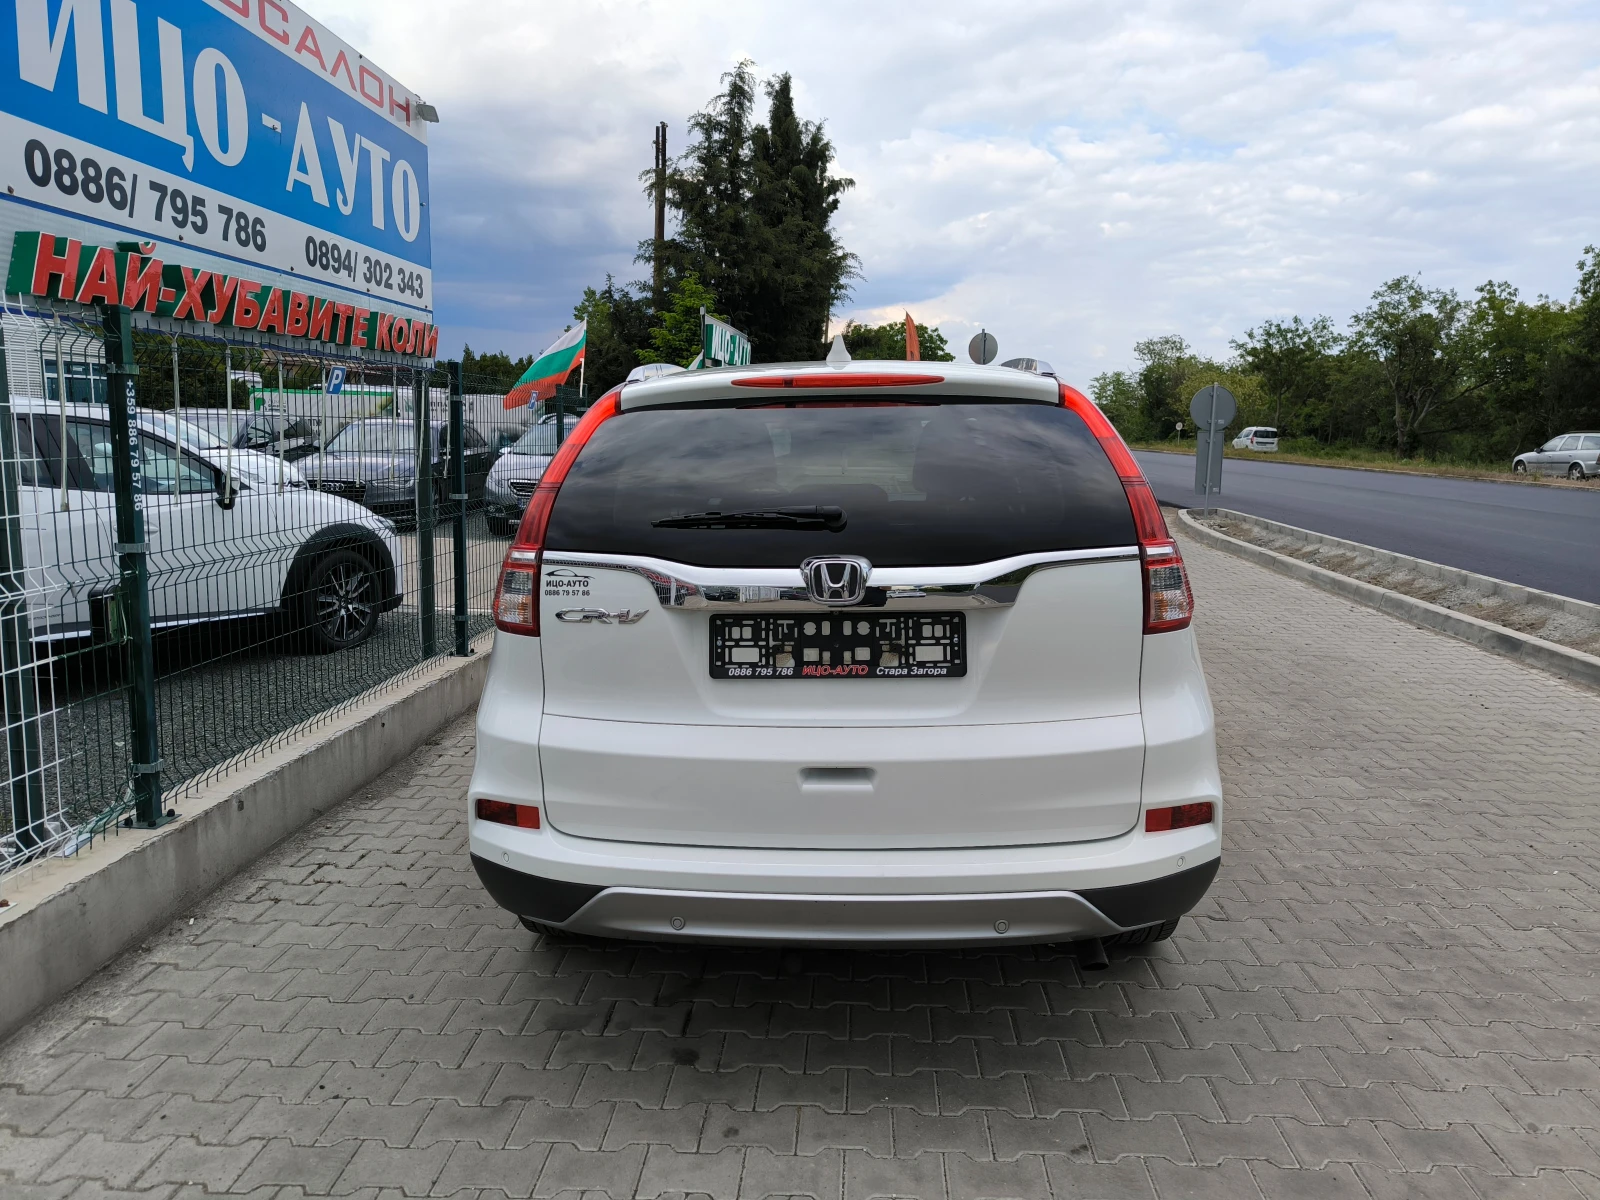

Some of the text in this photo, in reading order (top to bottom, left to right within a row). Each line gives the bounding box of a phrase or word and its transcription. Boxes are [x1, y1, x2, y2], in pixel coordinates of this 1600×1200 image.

[24, 138, 267, 253] 0886/ 795 786
[305, 235, 424, 299] 0894/ 302 343
[31, 232, 439, 358] НАЙ-ХУБАВИТЕ КОЛИ
[126, 379, 143, 511] +359 886 79 57 86
[546, 580, 589, 588] ИЦО-АУТО
[555, 608, 649, 624] CR-V
[728, 668, 794, 676] 0886 795 786
[802, 665, 869, 676] ИЦО-АУТО
[876, 667, 947, 677] Стара Загора
